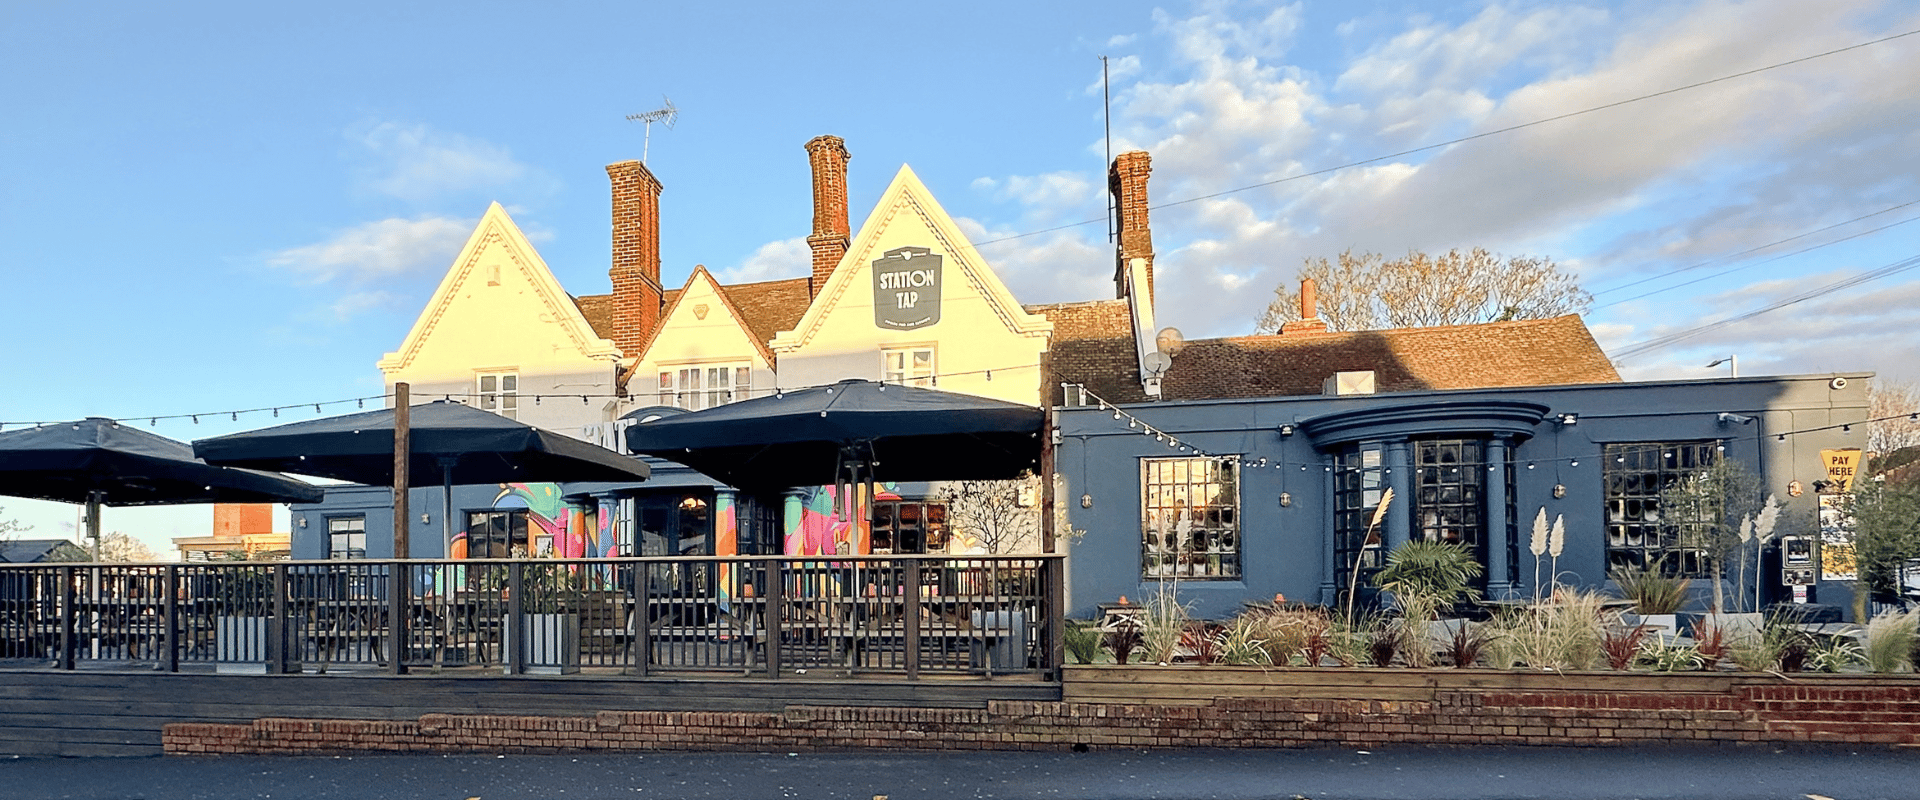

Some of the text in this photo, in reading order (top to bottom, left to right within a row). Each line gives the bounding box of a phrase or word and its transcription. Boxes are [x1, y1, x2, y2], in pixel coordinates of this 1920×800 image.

[880, 270, 935, 290] STATION
[896, 291, 919, 309] TAP
[1832, 456, 1850, 465] PAY
[1829, 467, 1853, 476] HERE
